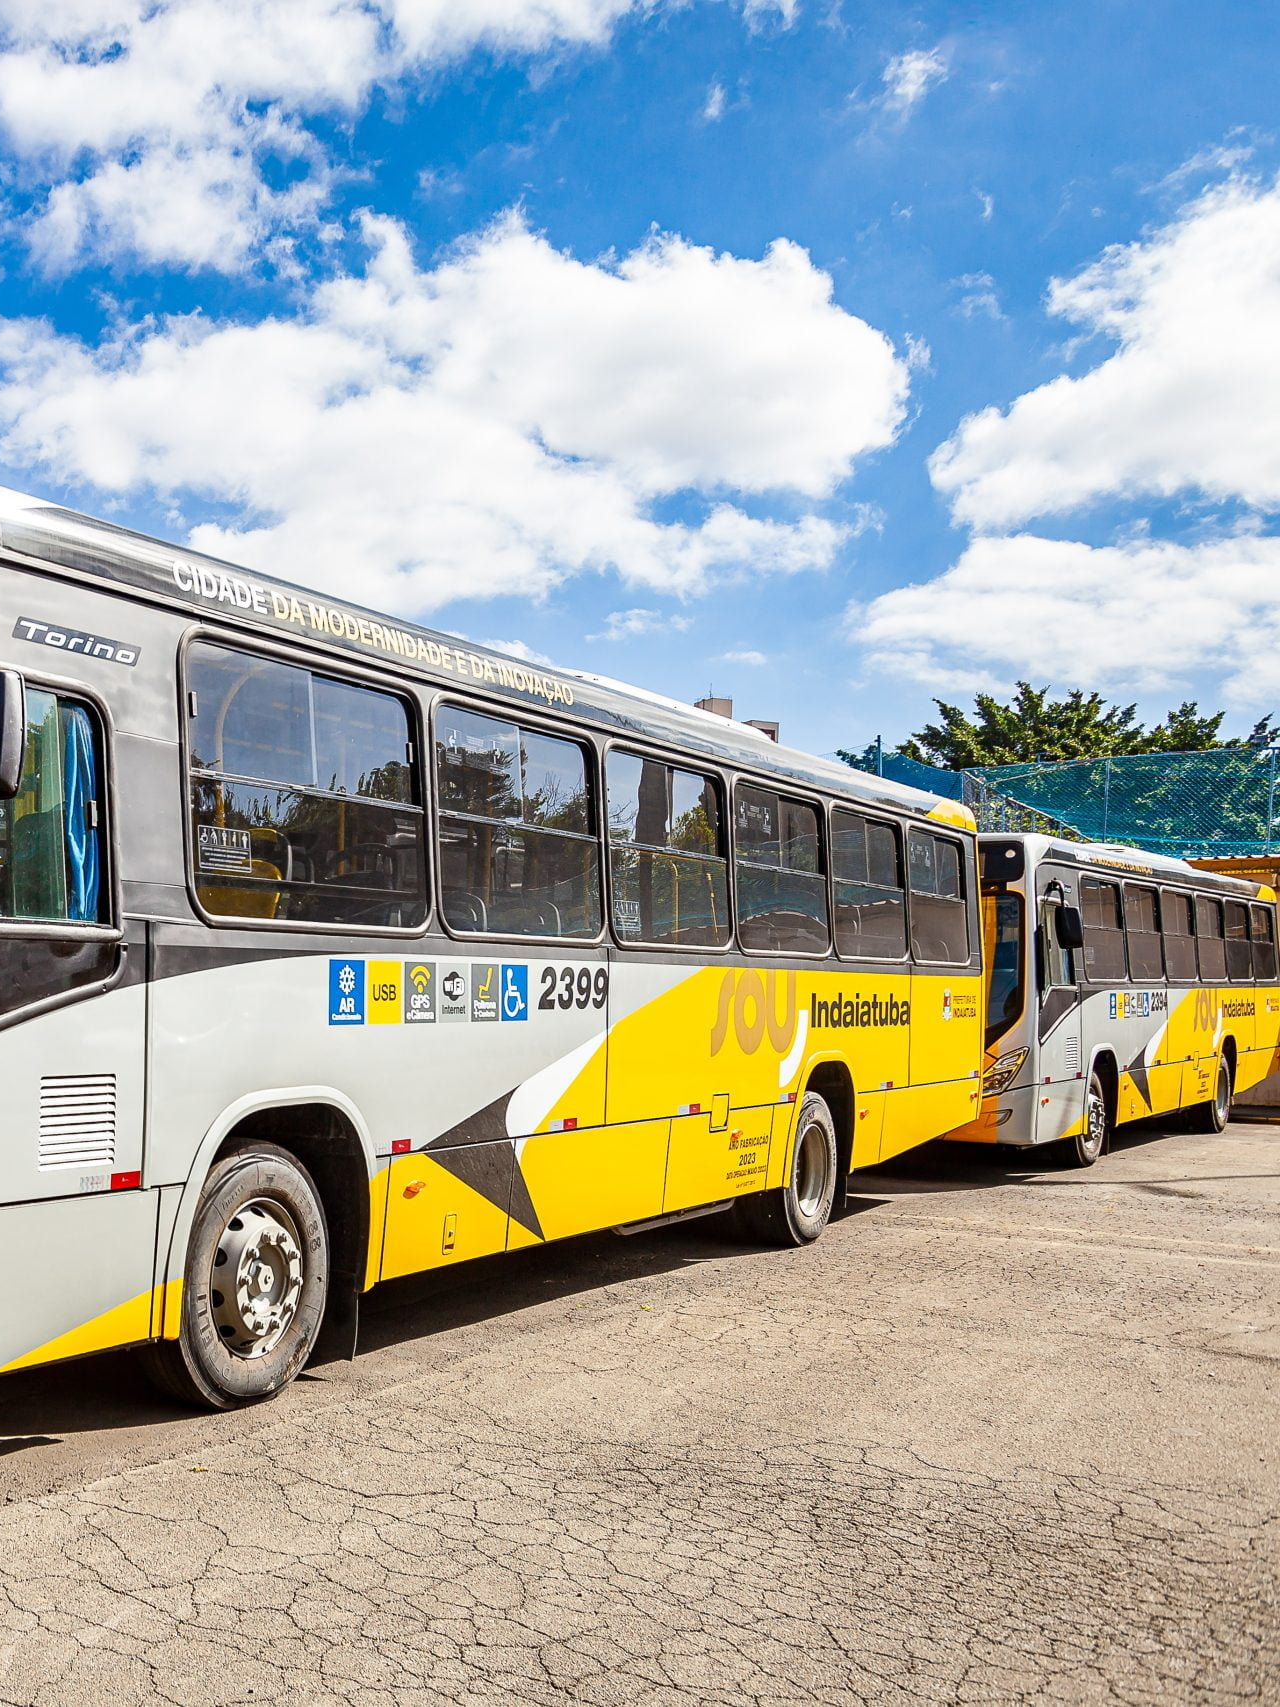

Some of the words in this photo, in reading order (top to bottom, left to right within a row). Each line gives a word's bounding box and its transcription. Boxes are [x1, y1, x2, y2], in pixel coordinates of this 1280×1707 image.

[20, 620, 136, 664] Torino
[172, 560, 268, 614] CIDADE
[271, 590, 306, 626] DA
[308, 602, 453, 671] MODERNIDADE
[454, 648, 469, 676] E
[469, 655, 496, 684] DA
[496, 662, 574, 706] INOVAÇÃO
[373, 984, 397, 1001] USB
[538, 967, 608, 1010] 2399
[339, 998, 355, 1012] AR
[411, 995, 430, 1009] GPS
[442, 1004, 466, 1015] Internet
[811, 993, 910, 1029] Indaiatuba
[1222, 999, 1256, 1018] Indaiatuba
[738, 1152, 756, 1166] 2023
